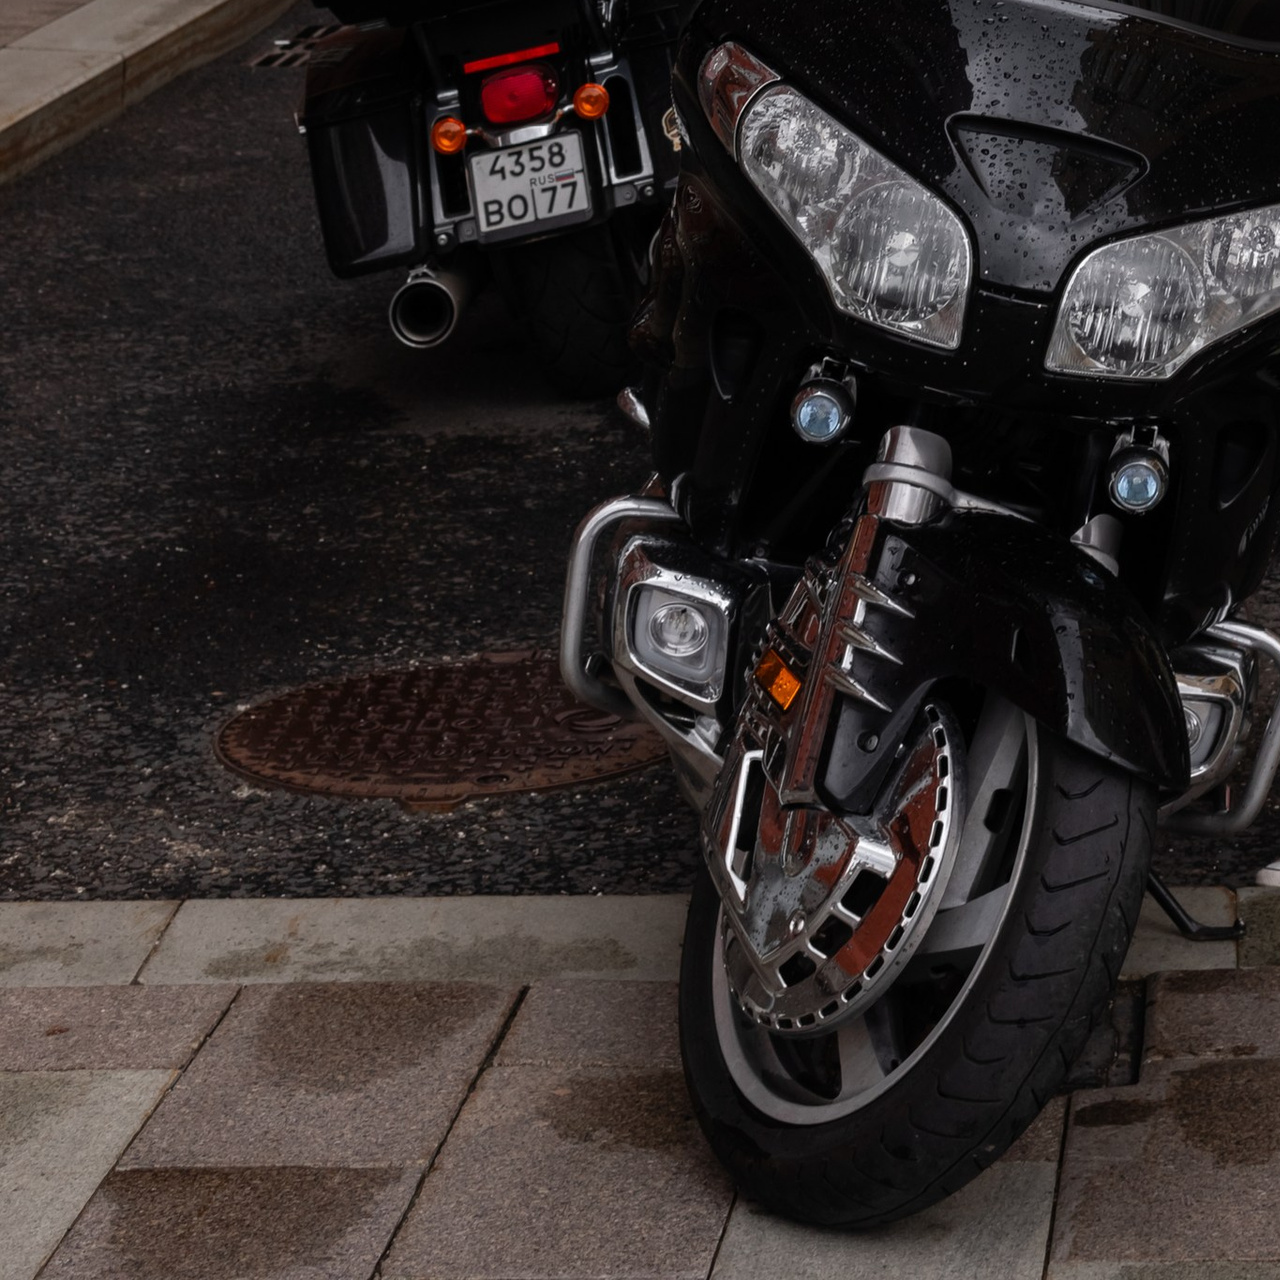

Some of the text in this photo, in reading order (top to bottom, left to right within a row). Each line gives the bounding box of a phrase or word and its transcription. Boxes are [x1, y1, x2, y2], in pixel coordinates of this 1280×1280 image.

[489, 142, 566, 180] 4358
[529, 173, 555, 187] RUS
[541, 181, 577, 214] 77
